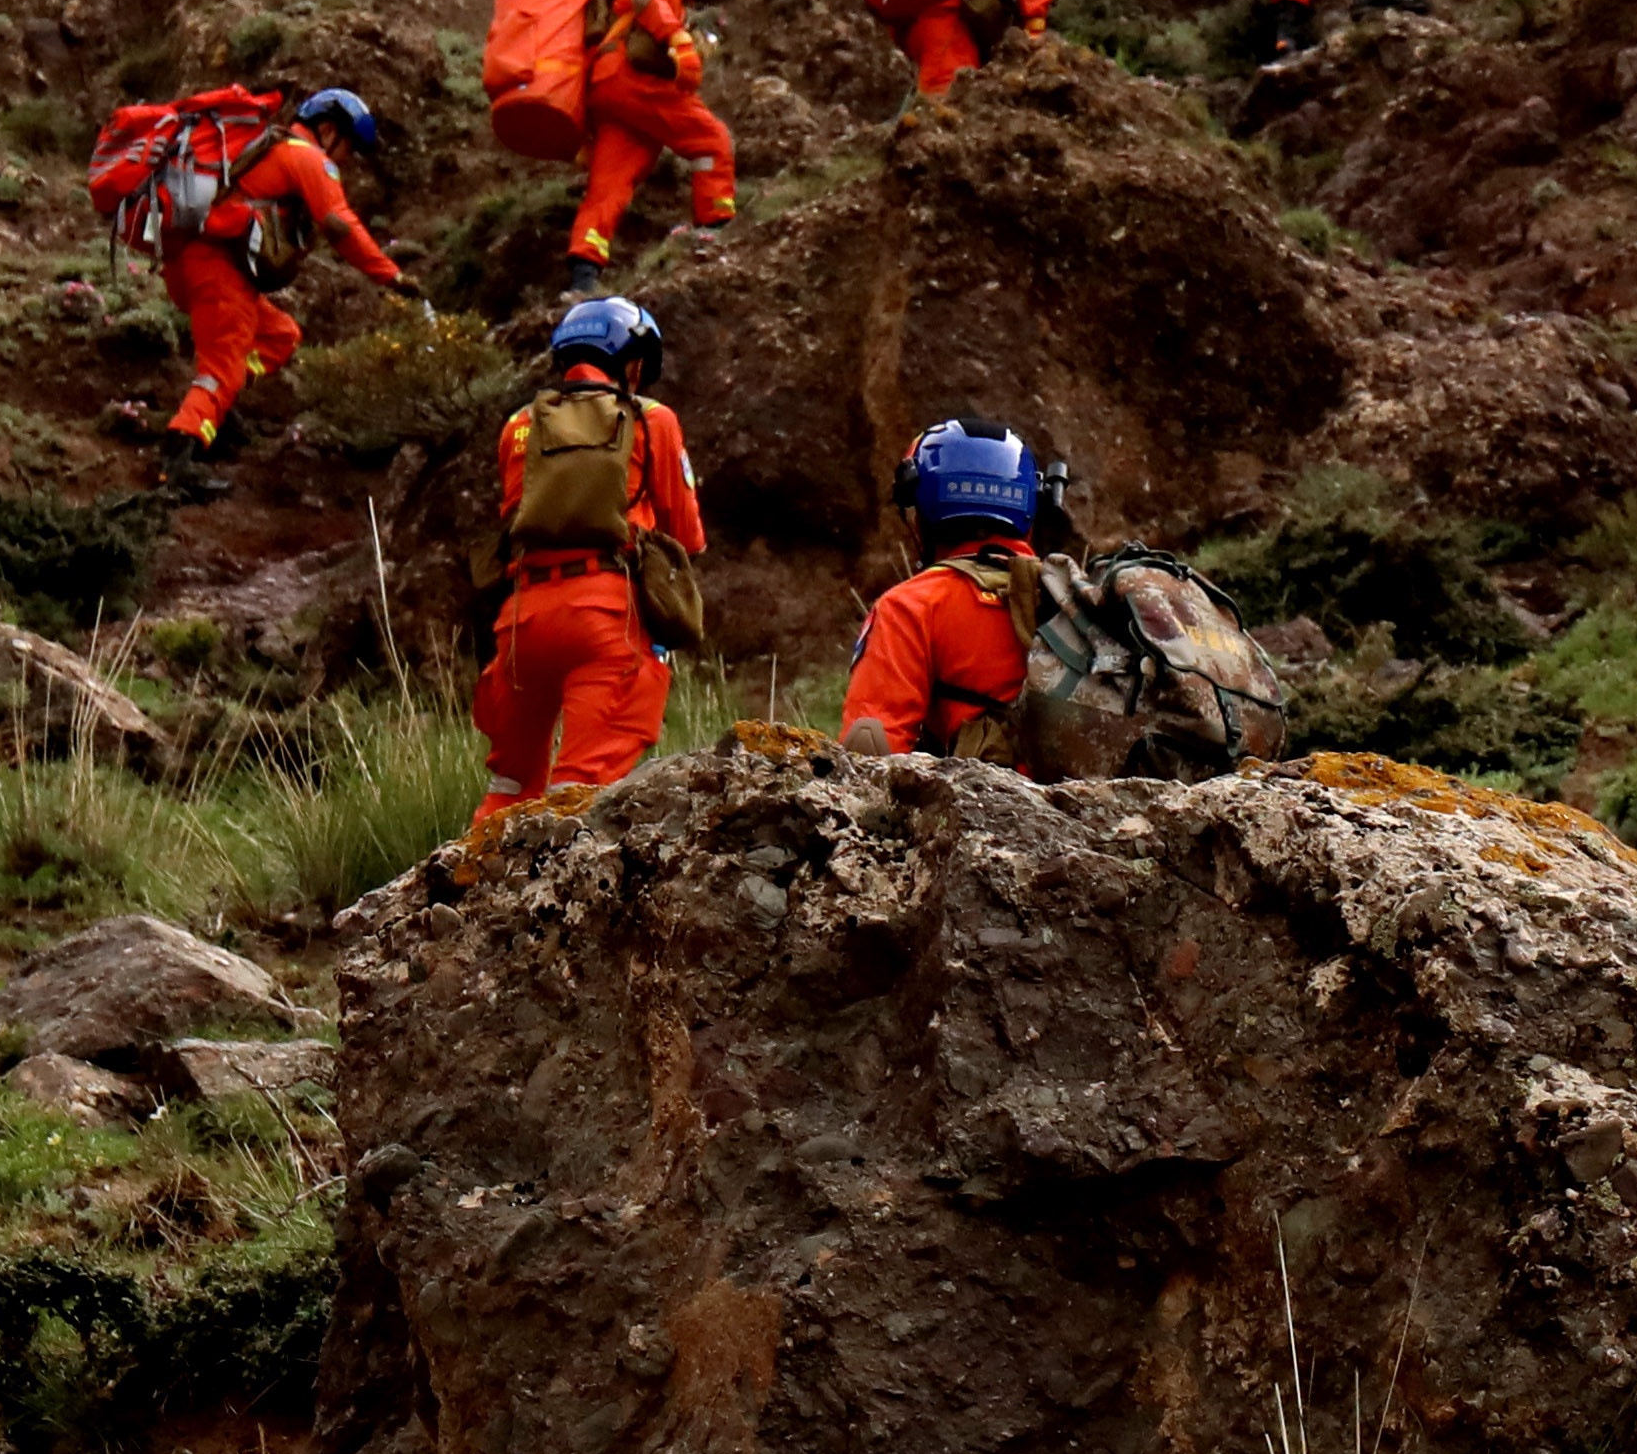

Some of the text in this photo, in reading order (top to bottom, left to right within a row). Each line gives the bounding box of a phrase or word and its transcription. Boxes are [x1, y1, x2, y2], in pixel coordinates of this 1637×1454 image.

[947, 481, 1024, 500] 中国森林消防
